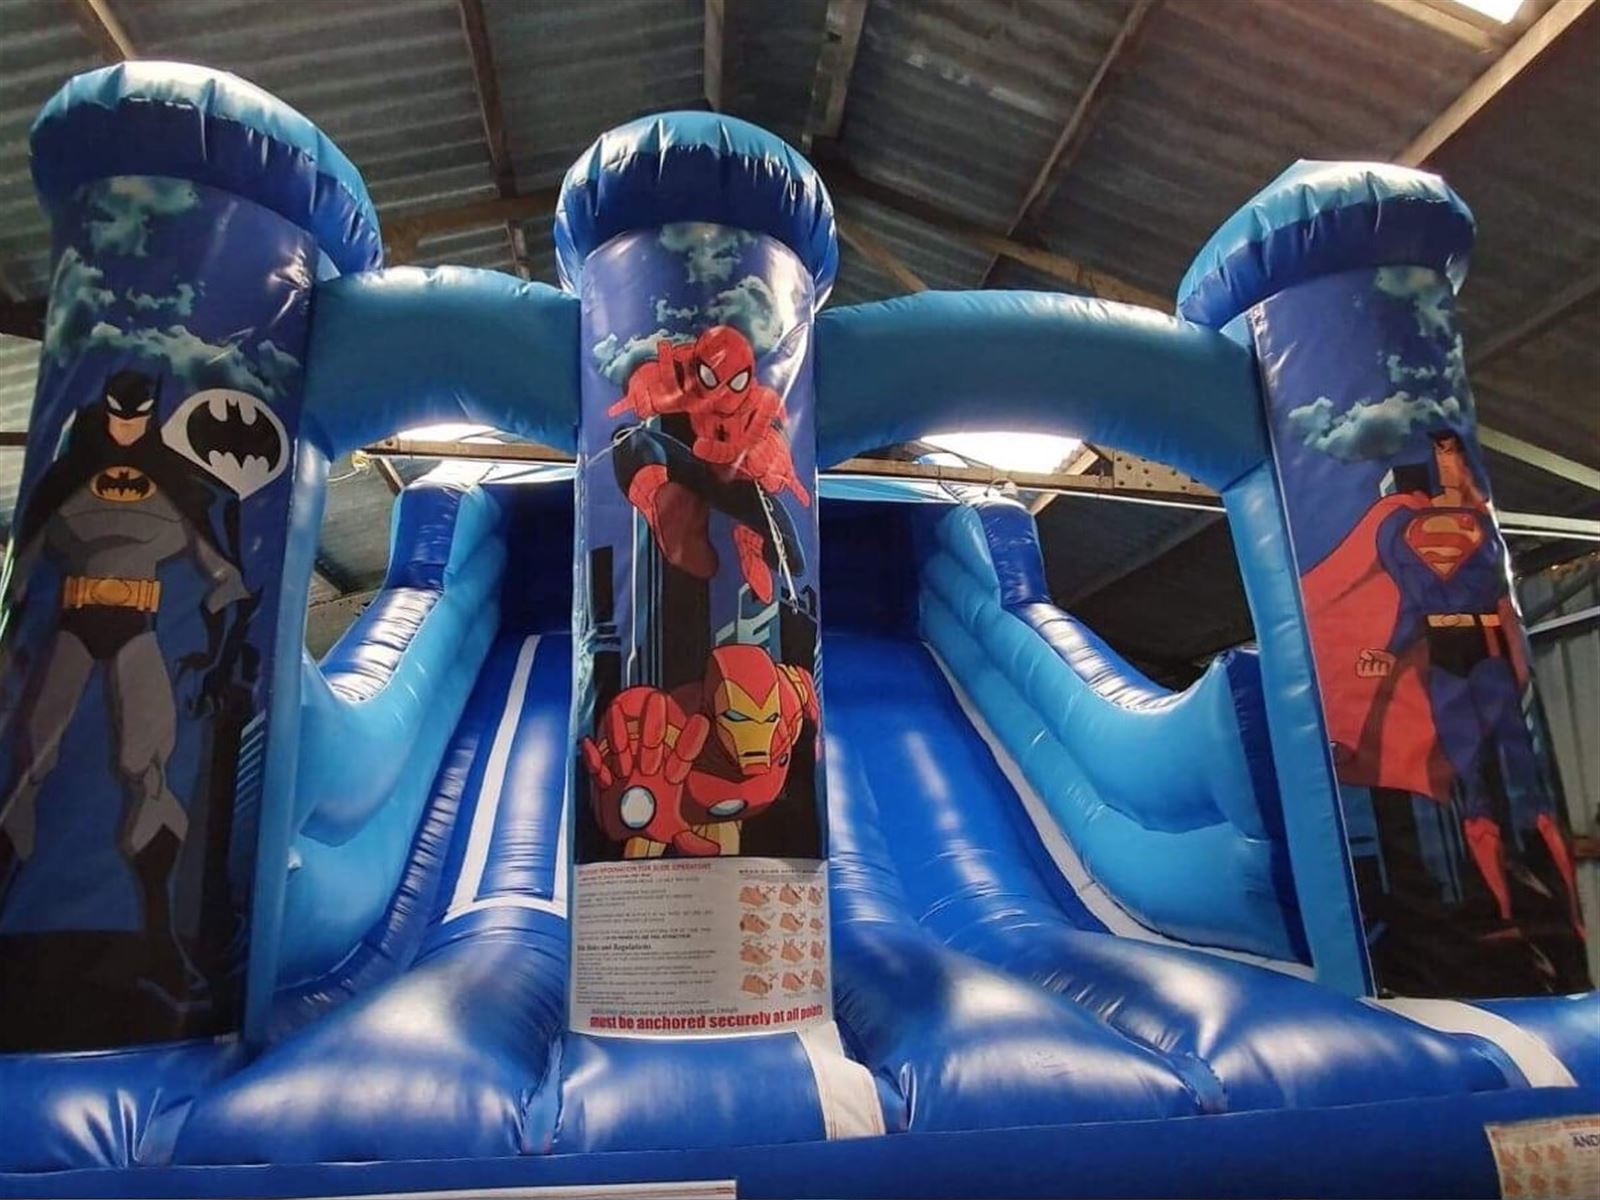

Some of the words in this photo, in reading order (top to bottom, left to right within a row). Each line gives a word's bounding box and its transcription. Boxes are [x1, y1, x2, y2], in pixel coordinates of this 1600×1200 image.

[619, 1015, 634, 1029] be
[636, 1015, 706, 1029] anchored
[709, 1011, 771, 1028] securely
[773, 1010, 785, 1023] at
[787, 1007, 799, 1021] all
